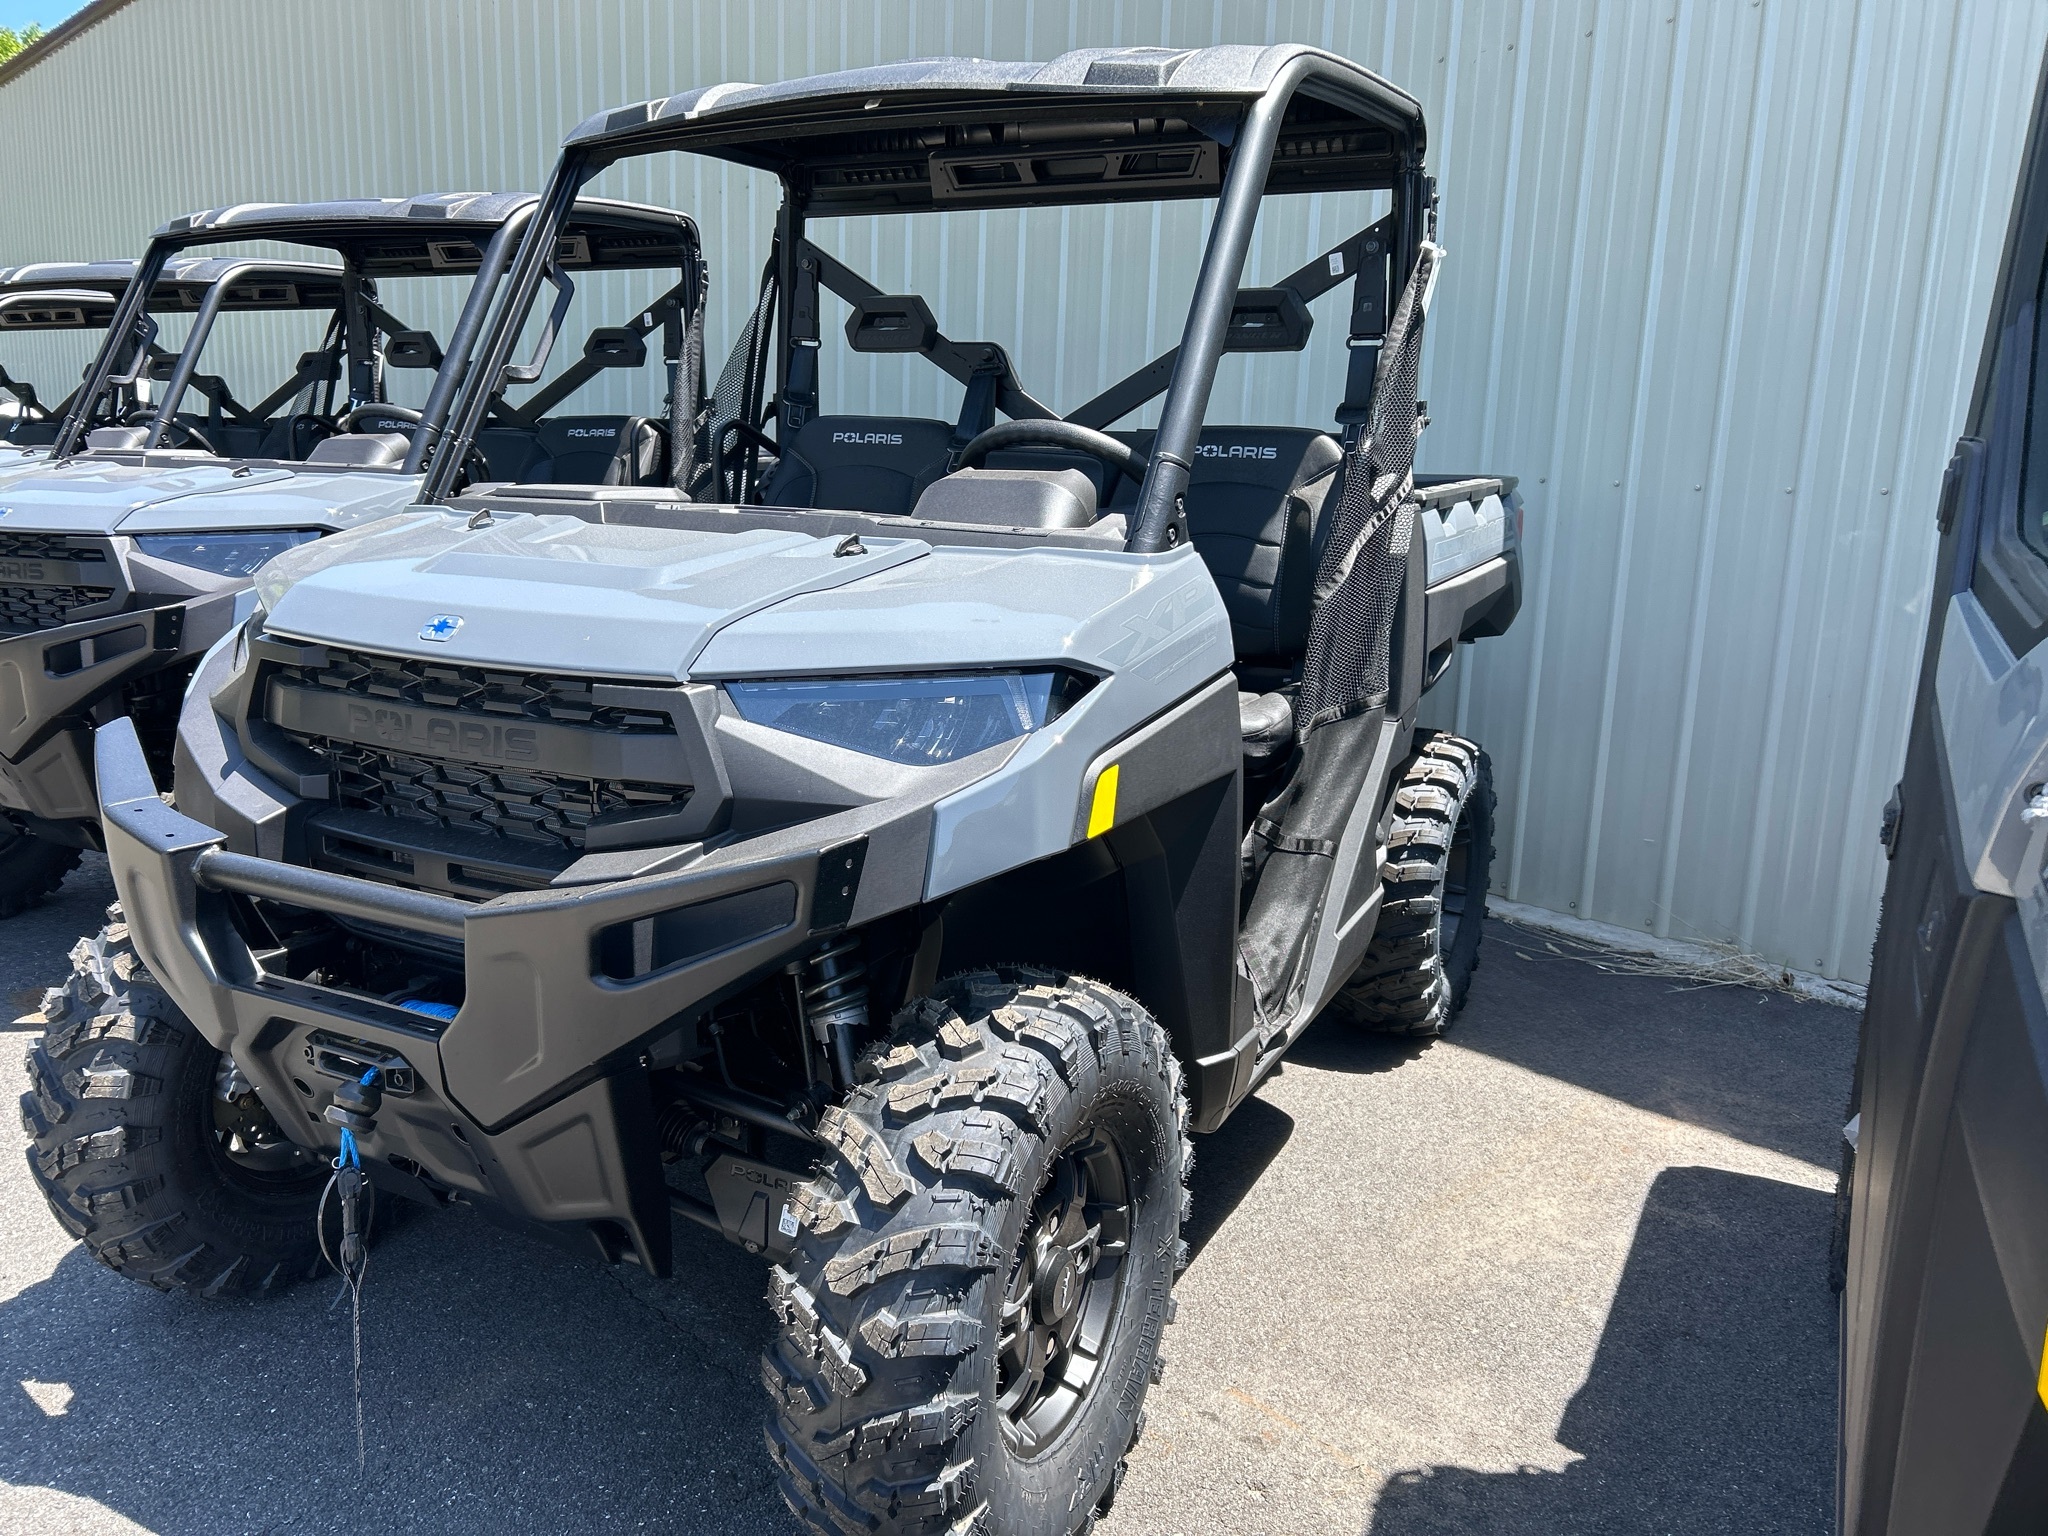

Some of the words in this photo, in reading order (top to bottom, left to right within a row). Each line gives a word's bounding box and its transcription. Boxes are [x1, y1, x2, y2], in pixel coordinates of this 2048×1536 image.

[567, 428, 616, 437] POLARIS
[832, 432, 903, 445] POLARIS
[1119, 575, 1208, 664] XP
[347, 703, 540, 763] POLARIS
